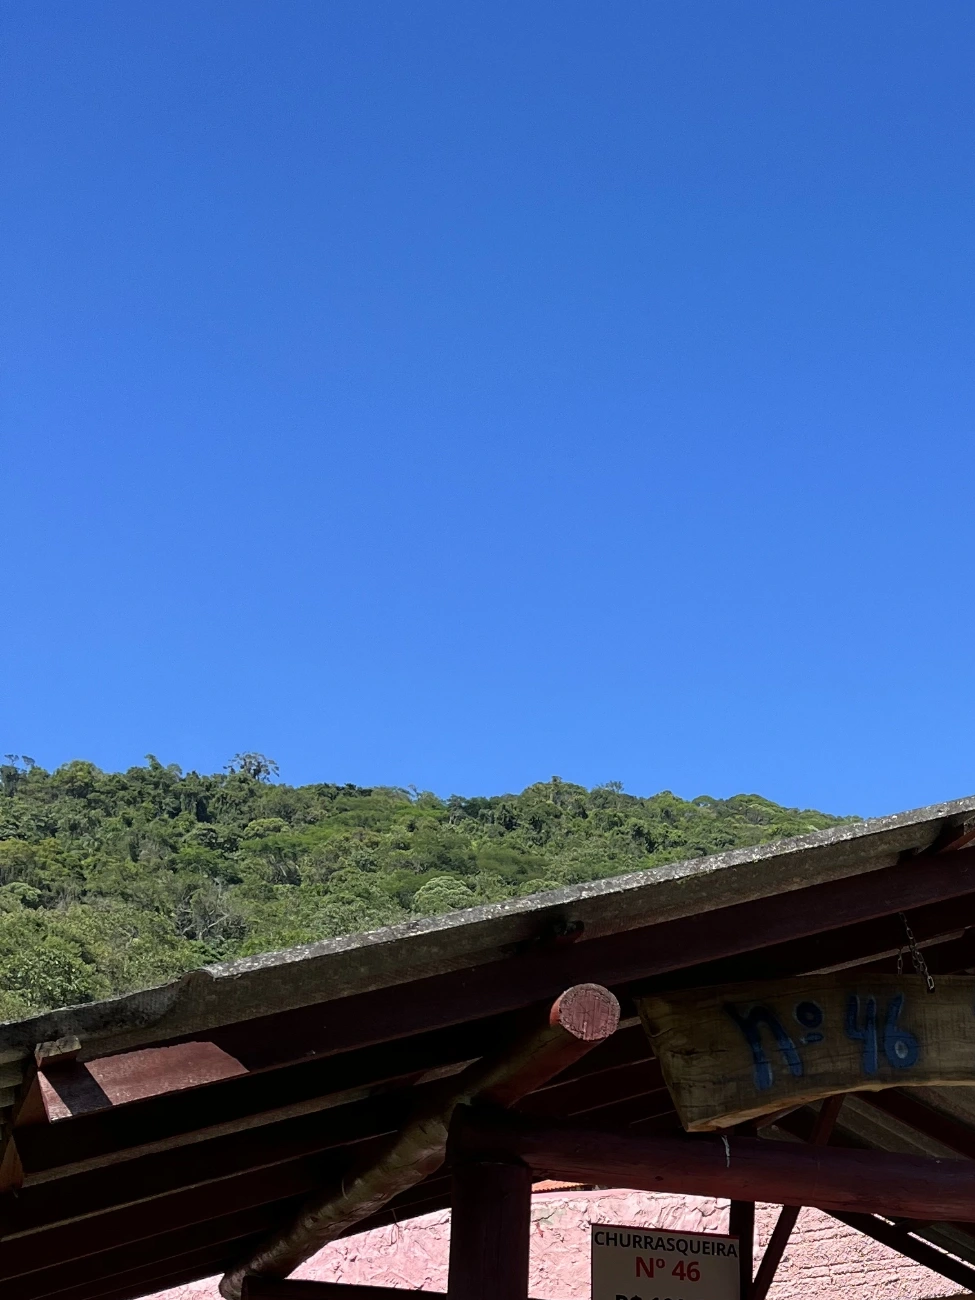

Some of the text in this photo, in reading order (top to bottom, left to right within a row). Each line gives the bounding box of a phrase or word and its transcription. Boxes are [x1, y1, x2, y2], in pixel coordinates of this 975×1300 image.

[846, 995, 920, 1077] 46
[594, 1231, 738, 1257] CHURRASQUEIRA
[635, 1256, 701, 1282] Nº 46
